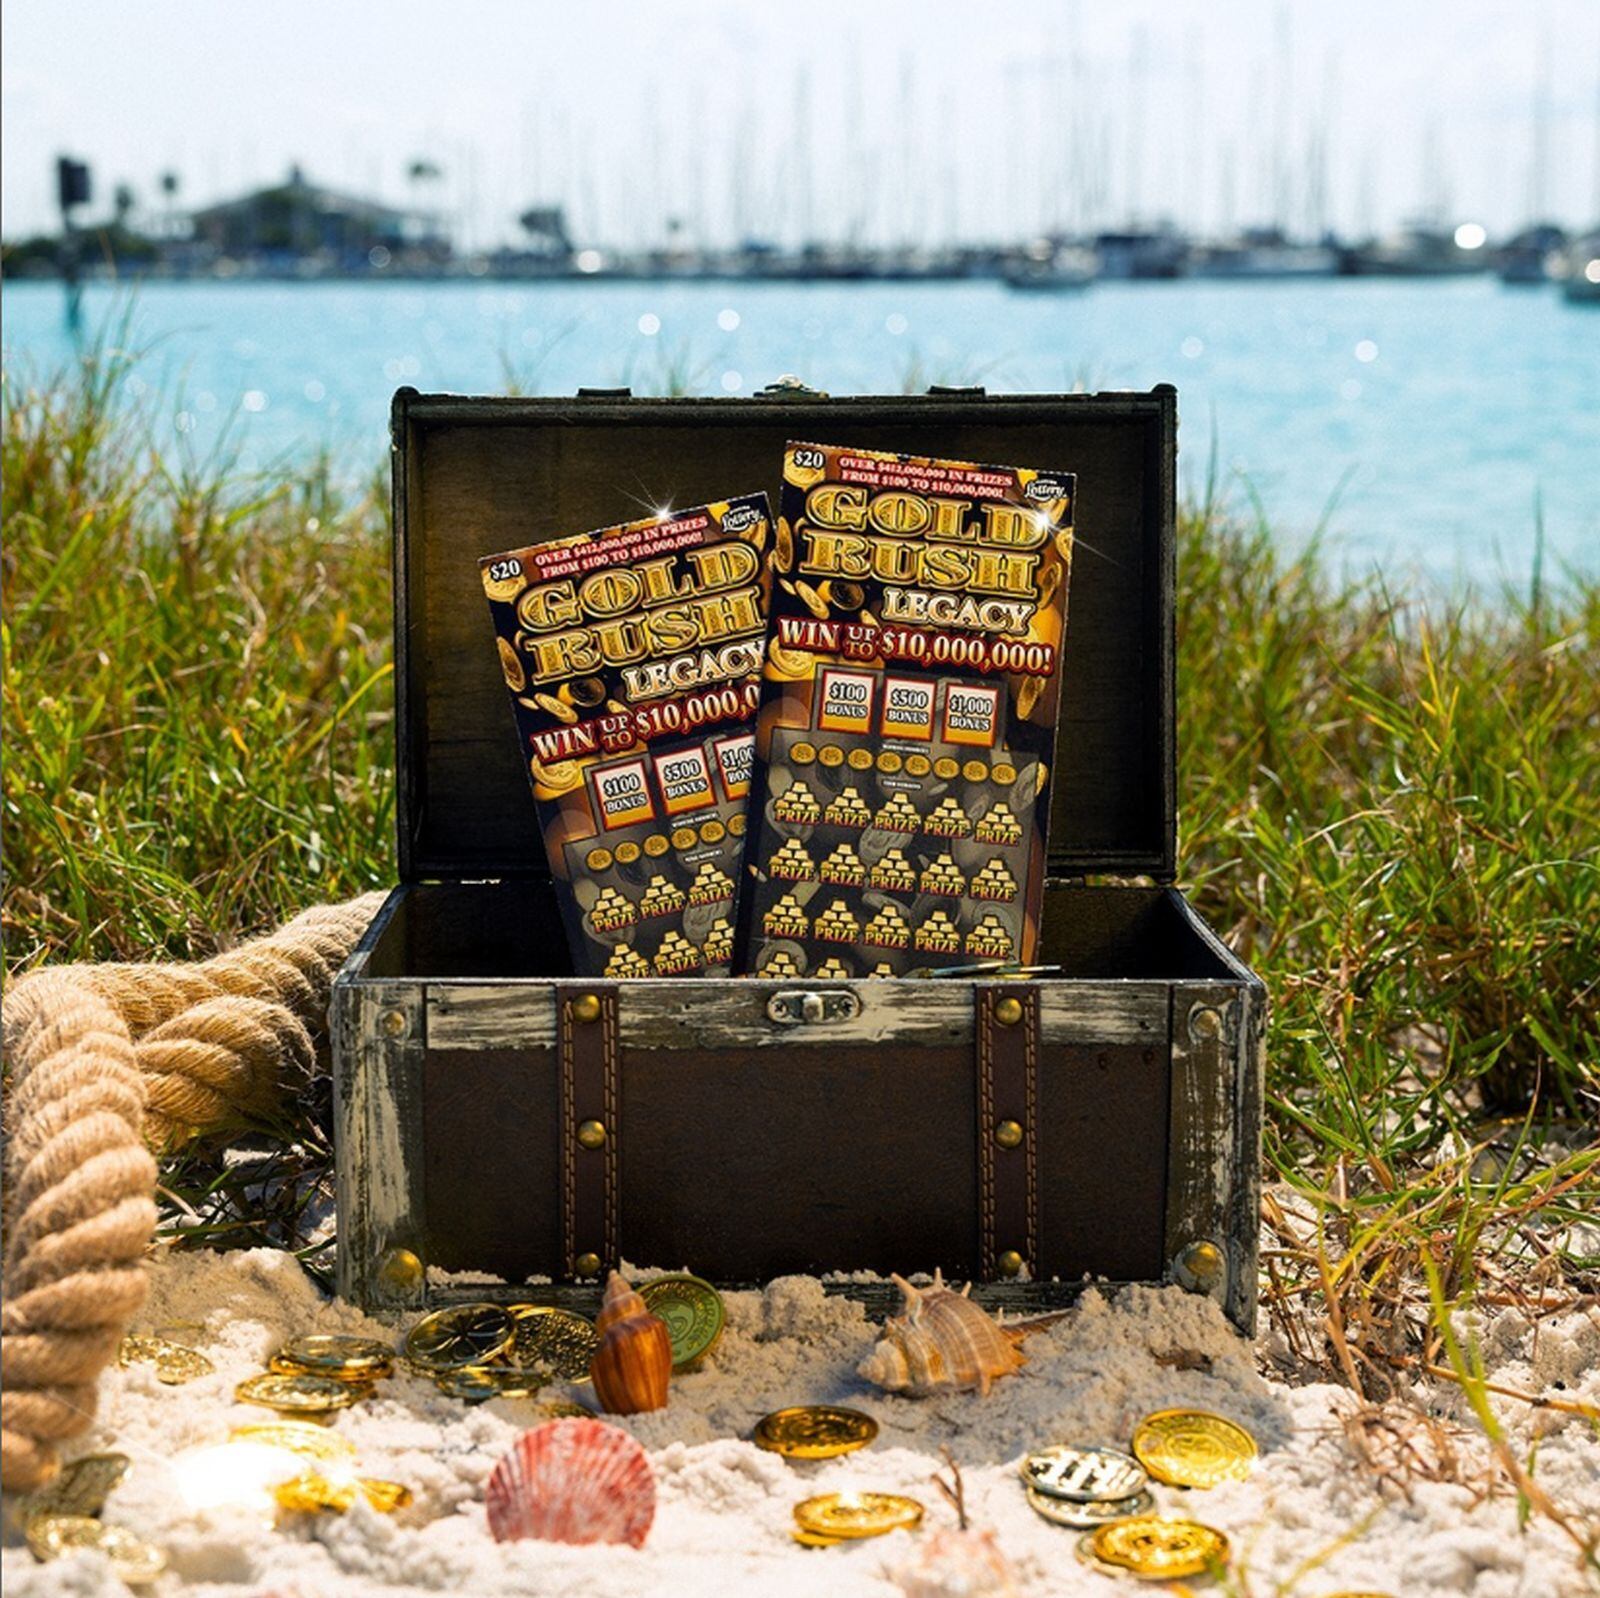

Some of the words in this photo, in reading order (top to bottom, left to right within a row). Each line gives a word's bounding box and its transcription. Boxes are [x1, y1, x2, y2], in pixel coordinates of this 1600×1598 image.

[794, 450, 824, 468] $20
[840, 458, 875, 470] OVER
[949, 471, 963, 480] IN
[966, 472, 1013, 486] PRIZES
[842, 471, 878, 484] FROM
[881, 476, 908, 487] $100
[911, 479, 928, 489] TO
[932, 482, 1003, 498] $10,000,000!
[806, 484, 1048, 550] GOLD
[536, 550, 571, 565] OVER
[575, 533, 641, 558] $412,000,000
[644, 528, 659, 540] IN
[661, 516, 708, 536] PRIZES
[542, 560, 579, 578] FROM
[582, 554, 608, 570] $100
[610, 549, 628, 562] TO
[632, 532, 702, 558] $10,000,000!
[800, 529, 1039, 599] RUSH
[490, 559, 521, 579] $20
[518, 541, 759, 631] GOLD
[882, 587, 1036, 636] LEGACY
[526, 586, 764, 685] RUSH
[780, 618, 839, 649] WIN
[849, 626, 875, 642] UP
[882, 630, 1051, 671] $10,000,000!
[848, 641, 873, 656] TO
[622, 640, 765, 700] LEGACY
[830, 681, 866, 702] $100
[891, 690, 928, 708] $500
[826, 701, 868, 718] BONUS
[887, 708, 928, 725] BONUS
[950, 696, 992, 716] $1,000
[950, 714, 990, 731] BONUS
[534, 724, 594, 758] WIN
[600, 715, 627, 732] UP
[603, 730, 632, 748] TO
[664, 760, 700, 781] $500
[604, 774, 640, 797] $100
[666, 779, 707, 798] BONUS
[606, 794, 646, 813] BONUS
[775, 807, 820, 825] PRIZE
[824, 811, 868, 828] PRIZE
[874, 814, 918, 833] PRIZE
[923, 820, 968, 838] PRIZE
[975, 827, 1020, 846] PRIZE
[770, 863, 814, 882] PRIZE
[820, 869, 864, 886] PRIZE
[870, 874, 914, 892] PRIZE
[920, 879, 964, 896] PRIZE
[970, 884, 1014, 901] PRIZE
[594, 912, 637, 932] PRIZE
[641, 898, 684, 919] PRIZE
[689, 886, 733, 905] PRIZE
[764, 920, 809, 938] PRIZE
[814, 926, 858, 943] PRIZE
[865, 930, 909, 947] PRIZE
[915, 936, 959, 953] PRIZE
[964, 941, 1010, 958] PRIZE
[656, 955, 700, 976] PRIZE
